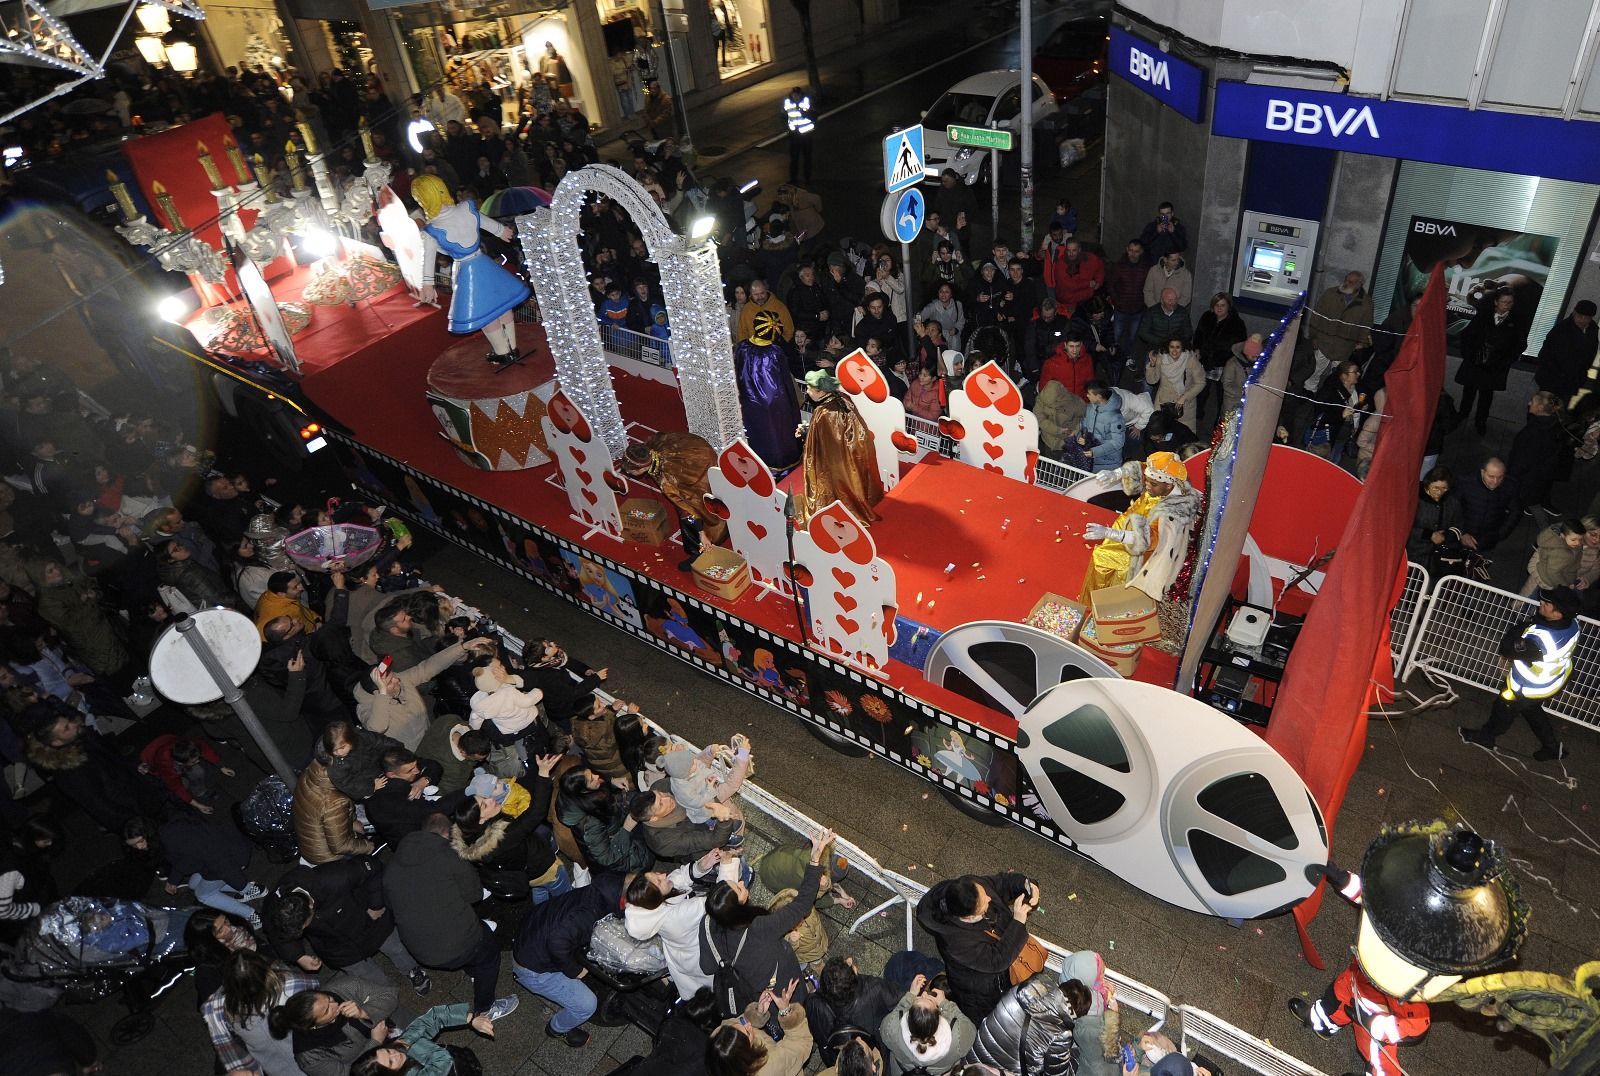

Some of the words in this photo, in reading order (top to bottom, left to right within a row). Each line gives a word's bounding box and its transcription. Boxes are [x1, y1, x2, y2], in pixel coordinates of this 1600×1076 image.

[1130, 46, 1171, 91] BBVA
[1265, 99, 1380, 139] BBVA
[1270, 226, 1289, 234] BBVA
[1414, 221, 1456, 237] BBVA
